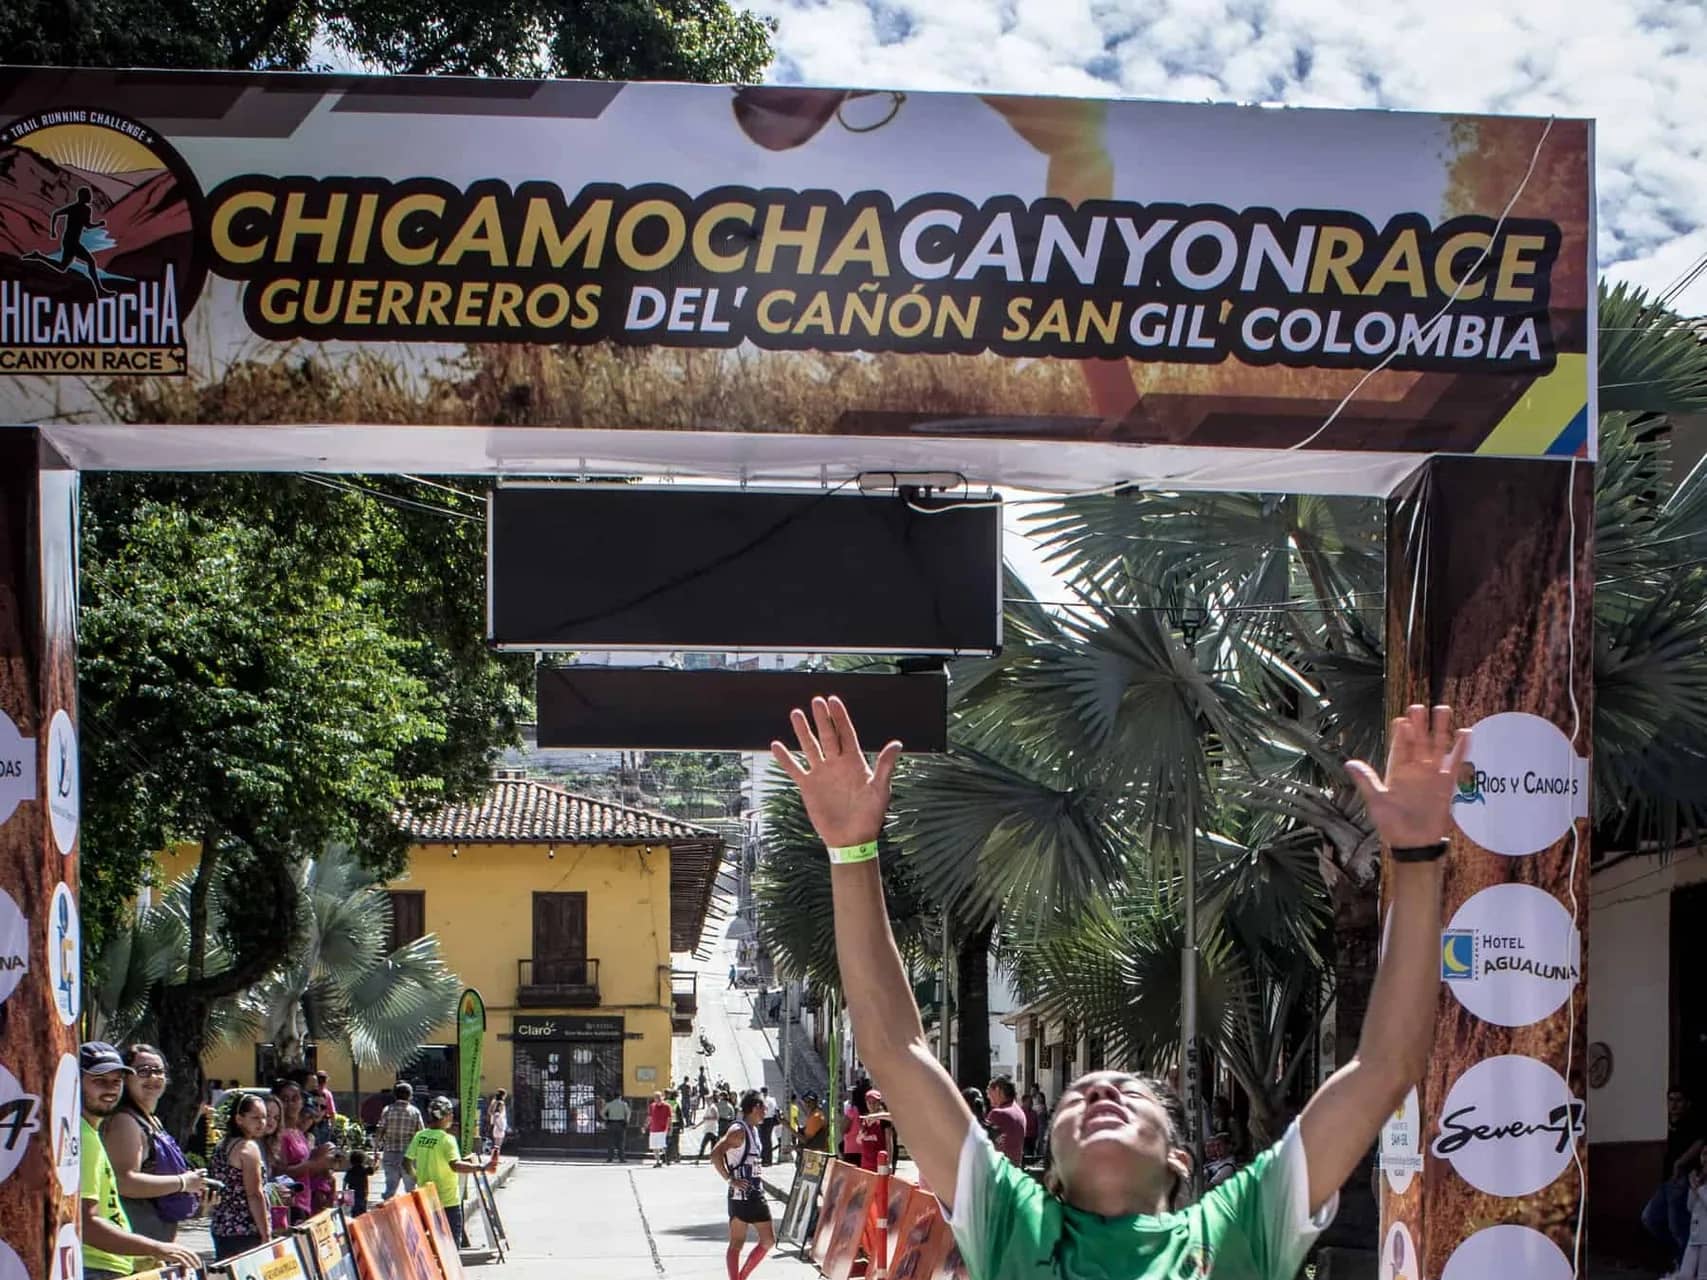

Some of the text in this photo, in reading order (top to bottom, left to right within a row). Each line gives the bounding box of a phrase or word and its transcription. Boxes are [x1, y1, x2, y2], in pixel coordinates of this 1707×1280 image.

[10, 111, 147, 141] TRAIL RUNNING CHALLENGE
[260, 278, 601, 330] GUERREROS
[757, 282, 982, 340] CAÑÓN
[1241, 306, 1542, 362] COLOMBIA
[0, 351, 163, 371] CANYON RACE
[1482, 934, 1525, 949] HOTEL
[1483, 955, 1579, 981] AGUALUNA
[518, 1023, 553, 1036] Claro
